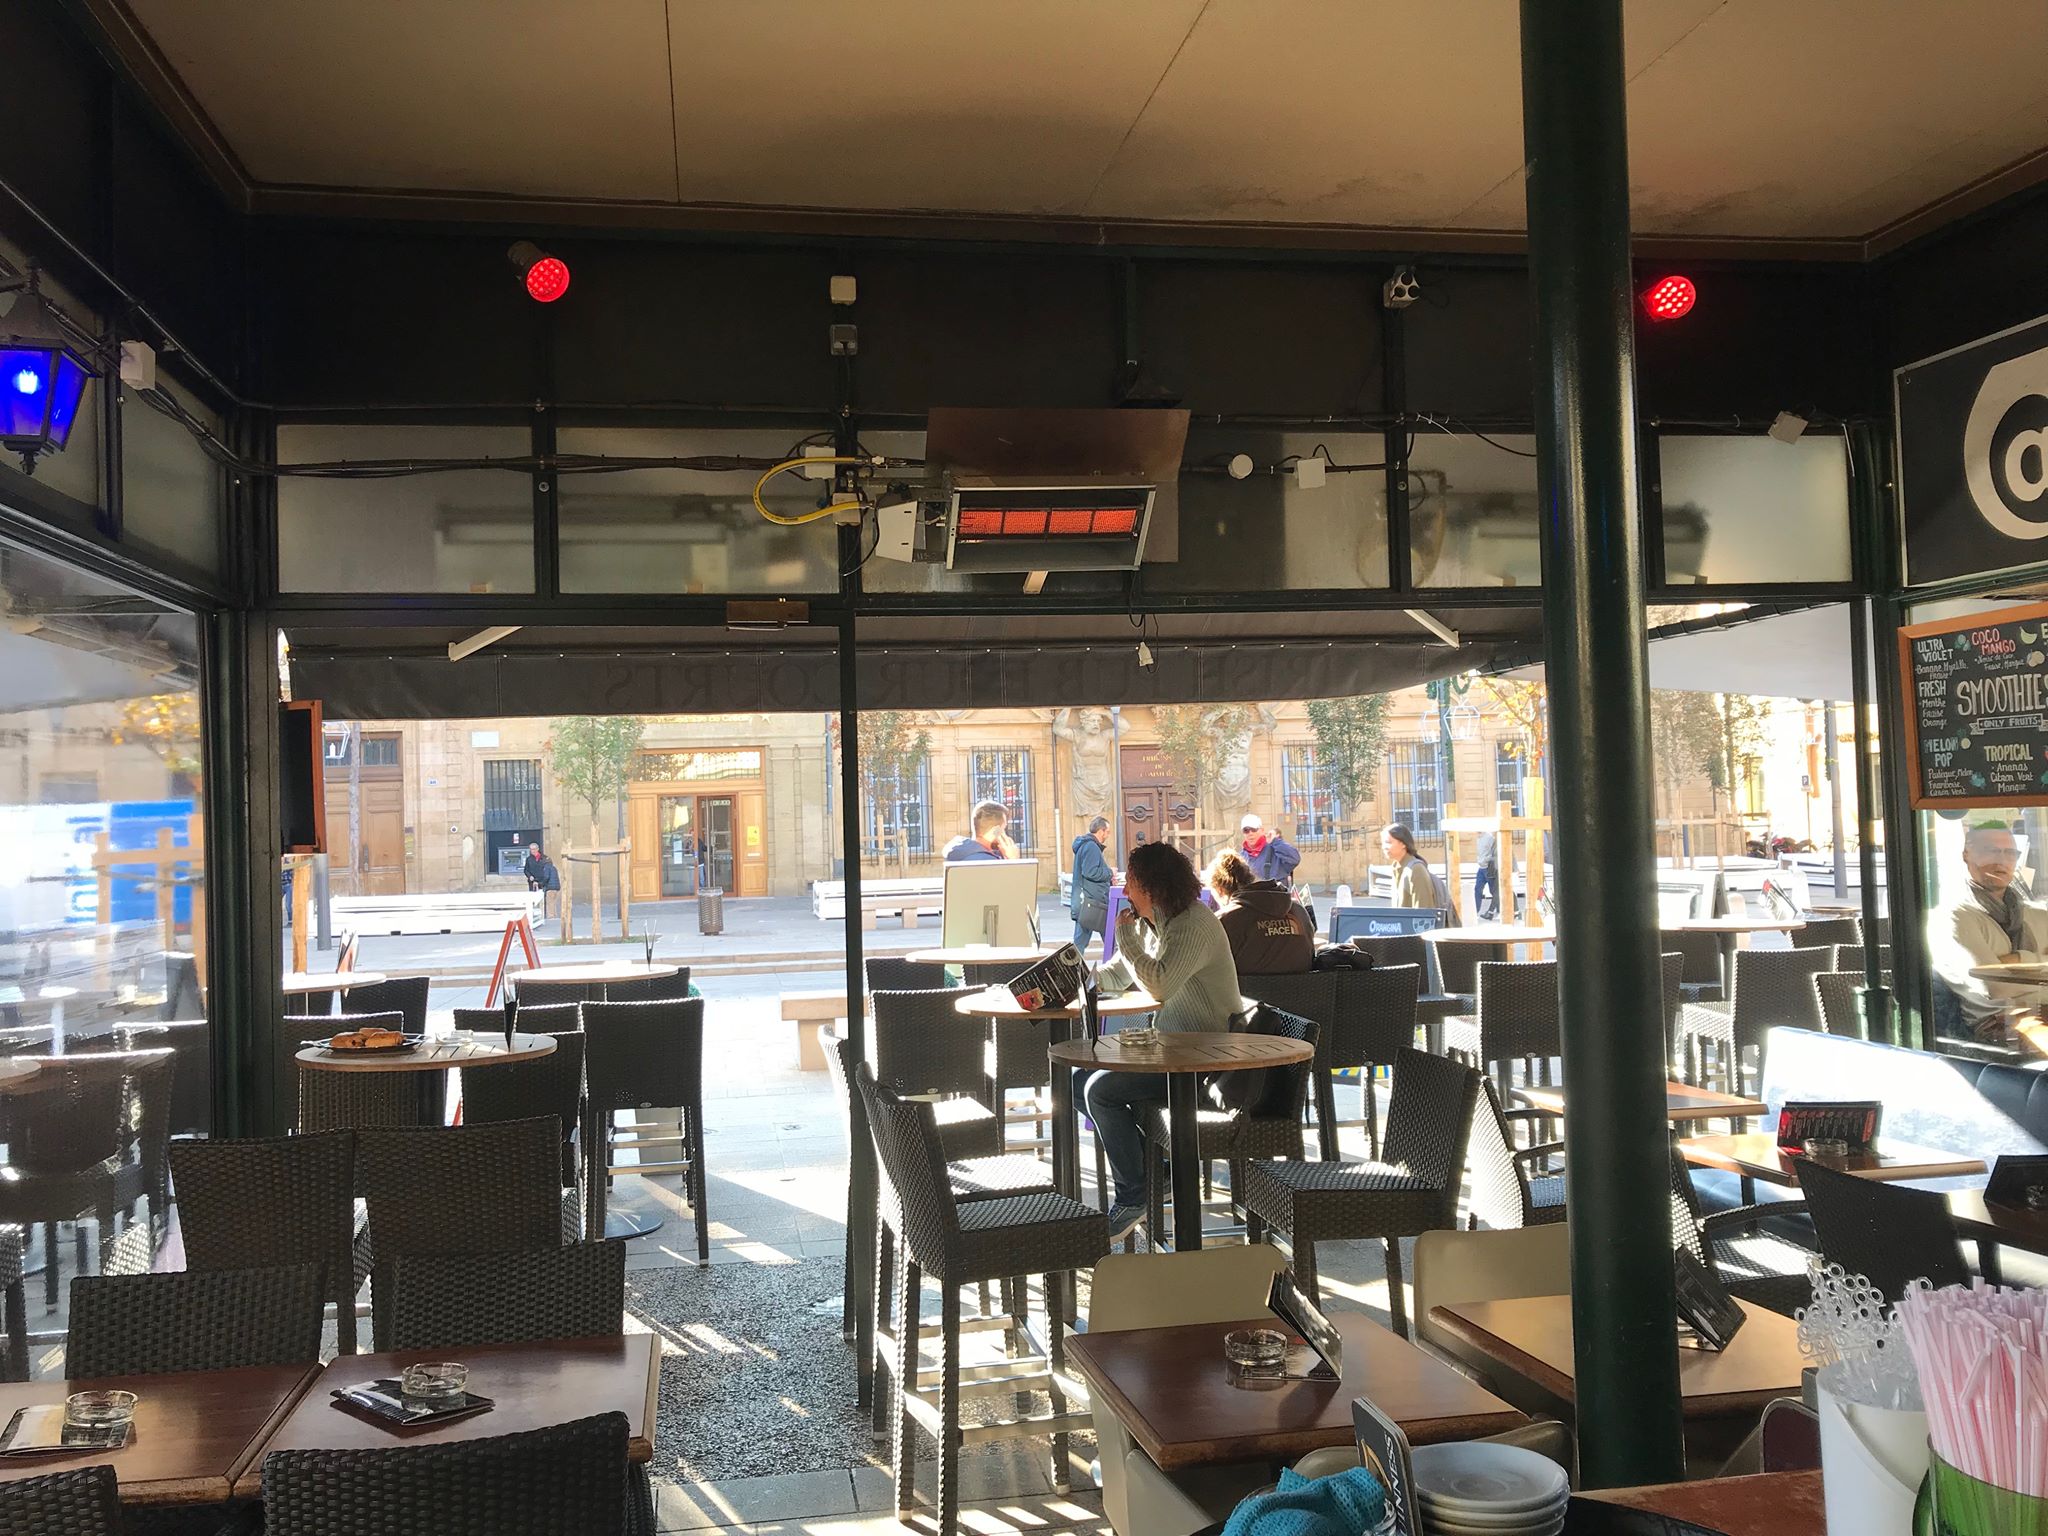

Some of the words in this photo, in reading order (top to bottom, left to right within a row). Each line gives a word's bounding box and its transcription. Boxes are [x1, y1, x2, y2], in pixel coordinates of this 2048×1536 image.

[1971, 628, 2001, 646] COCO
[1917, 638, 1945, 653] ULTRA
[1981, 639, 2016, 656] MANGO
[1921, 649, 1954, 663] VIOLET
[1919, 680, 1947, 697] FRESH
[1957, 673, 2048, 716] SMOOTHIE
[1984, 719, 2004, 728] ONLY
[2009, 716, 2038, 727] FRUITS
[1924, 737, 1959, 753] MELON
[1934, 752, 1954, 767] POP
[1983, 744, 2034, 762] TROPICAL
[1996, 763, 2028, 772] Ananas
[1990, 772, 2014, 782] Citron
[2017, 772, 2034, 781] Vert
[1257, 919, 1290, 930] NORTH
[1268, 926, 1291, 936] FACE
